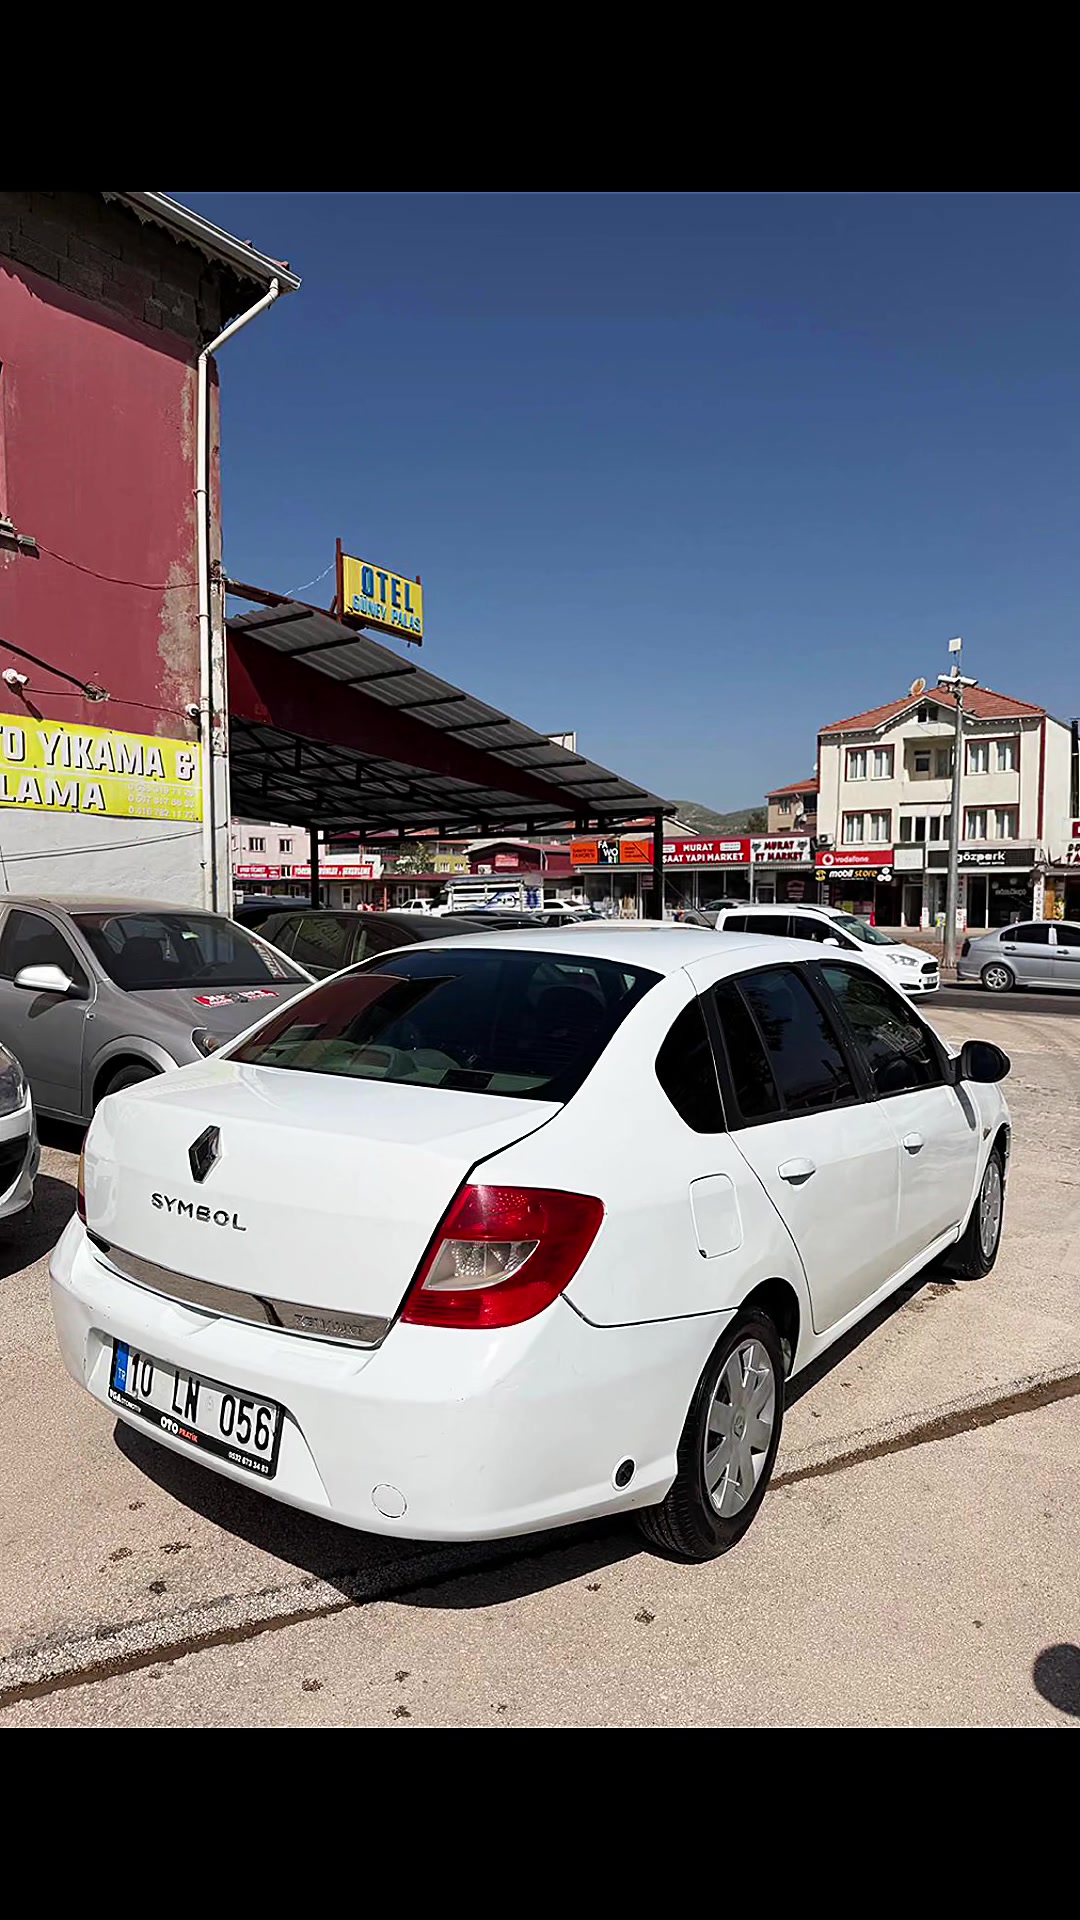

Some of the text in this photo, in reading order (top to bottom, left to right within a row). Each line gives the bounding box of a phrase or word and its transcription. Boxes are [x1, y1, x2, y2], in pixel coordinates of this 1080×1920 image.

[361, 565, 414, 613] OTEL
[352, 593, 421, 633] GÜNEY PALAS
[0, 725, 195, 781] O YIKAMA &
[0, 773, 107, 811] LAMA
[682, 842, 714, 852] MURAT
[764, 840, 795, 851] MURAT
[685, 853, 706, 863] YAPI
[707, 852, 744, 862] MARKET
[767, 851, 803, 861] MARKET
[835, 855, 870, 863] vodafone
[957, 850, 1005, 864] gözpark
[854, 869, 878, 877] store
[151, 1193, 248, 1232] SYMBOL
[118, 1367, 126, 1382] TR
[131, 1353, 272, 1450] 10 LN 056
[160, 1416, 179, 1435] OTO
